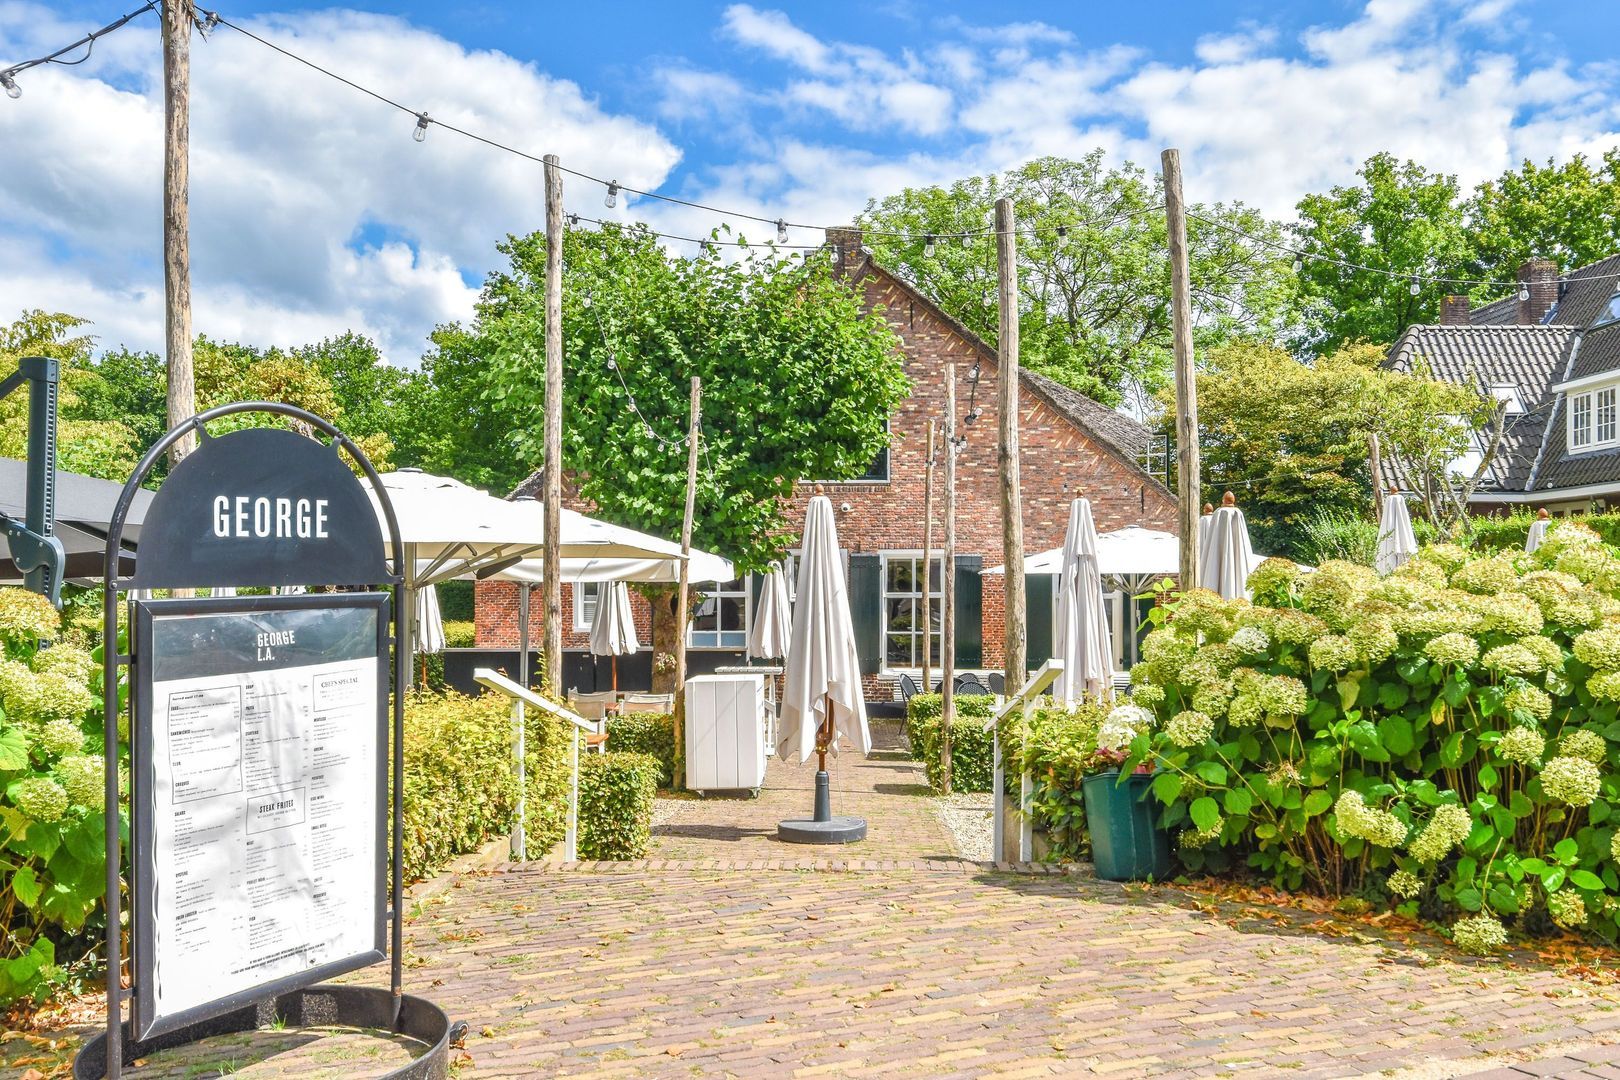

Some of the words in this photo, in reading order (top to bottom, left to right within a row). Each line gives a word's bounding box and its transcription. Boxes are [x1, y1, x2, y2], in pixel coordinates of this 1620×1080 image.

[213, 495, 329, 538] GEORGE
[257, 630, 296, 647] GEORGE
[257, 647, 275, 661] L.A.
[259, 803, 275, 813] STEAK
[276, 799, 294, 810] FRITES
